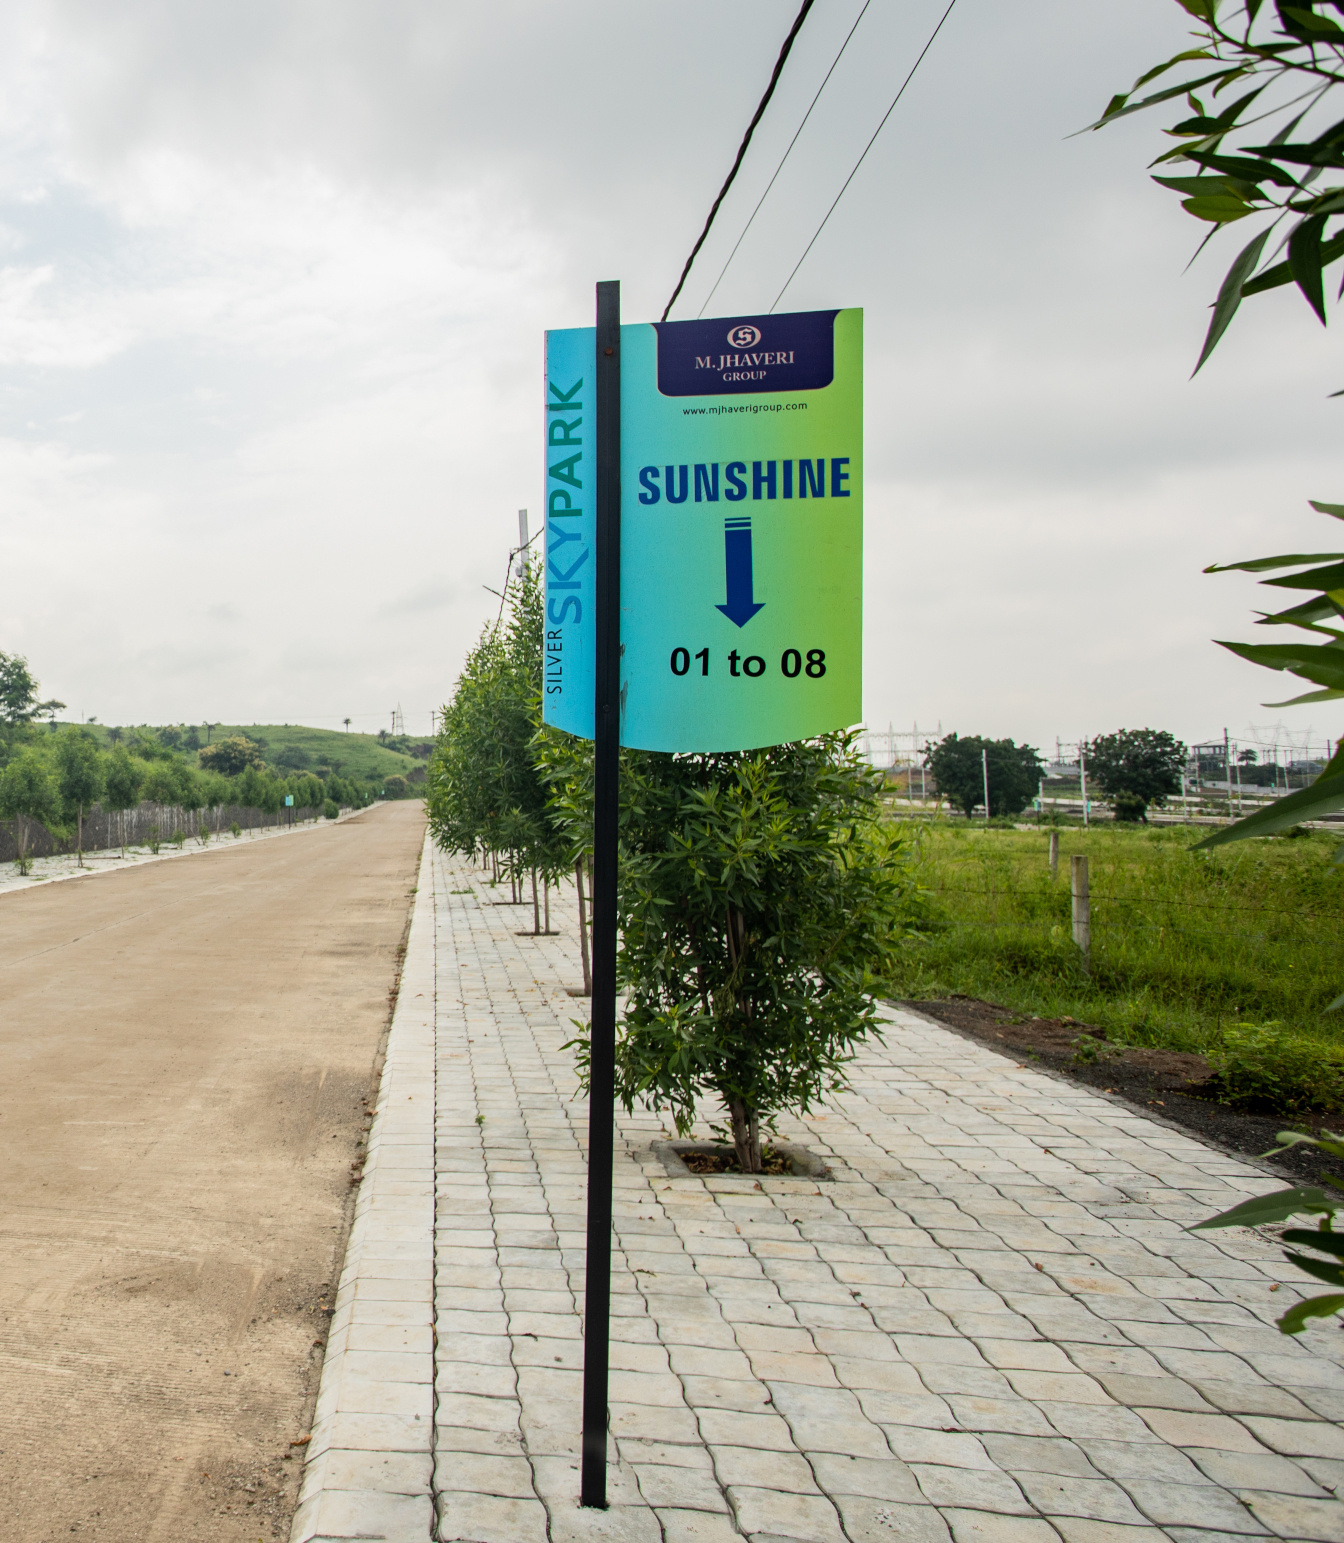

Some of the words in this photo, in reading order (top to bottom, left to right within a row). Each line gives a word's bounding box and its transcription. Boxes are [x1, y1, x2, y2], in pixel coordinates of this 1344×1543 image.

[722, 370, 767, 382] GROUP
[682, 402, 808, 416] www.mjhaverigroup.com
[638, 457, 851, 505] SUNSHINE
[546, 628, 563, 694] SILVER
[670, 647, 710, 676] 01
[727, 649, 766, 677] to
[780, 648, 826, 678] 08
